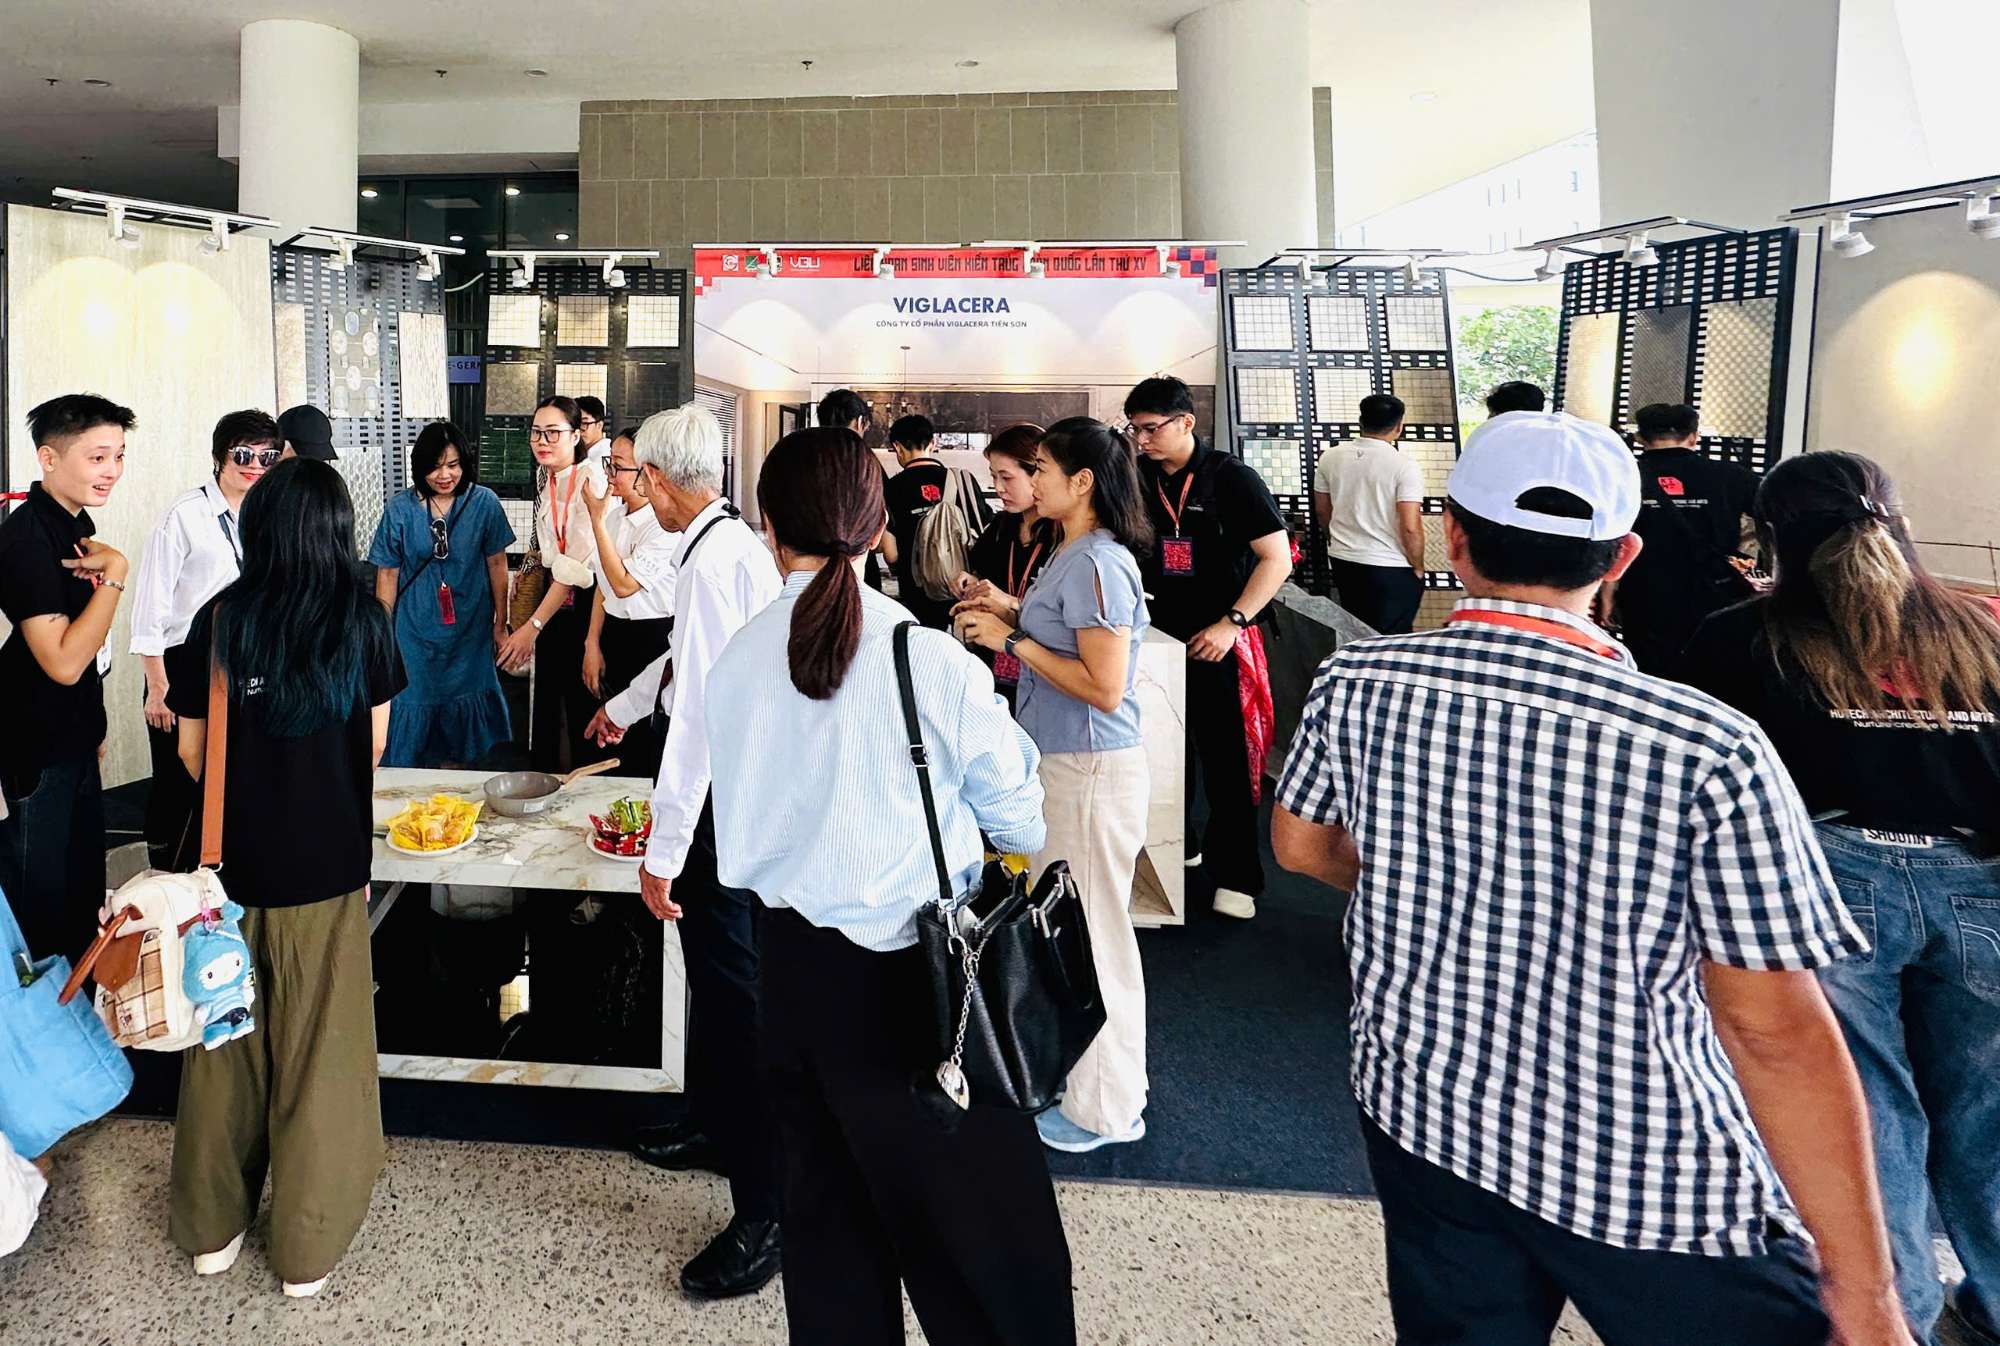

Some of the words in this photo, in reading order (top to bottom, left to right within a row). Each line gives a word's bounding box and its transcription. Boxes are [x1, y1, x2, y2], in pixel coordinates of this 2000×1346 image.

[911, 257, 935, 271] SINH
[938, 255, 964, 271] VIÊN
[1134, 257, 1147, 271] XV
[893, 297, 1010, 313] VIGLACERA
[876, 319, 898, 328] CÔNG
[900, 320, 909, 328] TY
[946, 320, 989, 328] VIGLACERA
[1947, 711, 1969, 722] AND
[1970, 711, 1994, 723] ARTS
